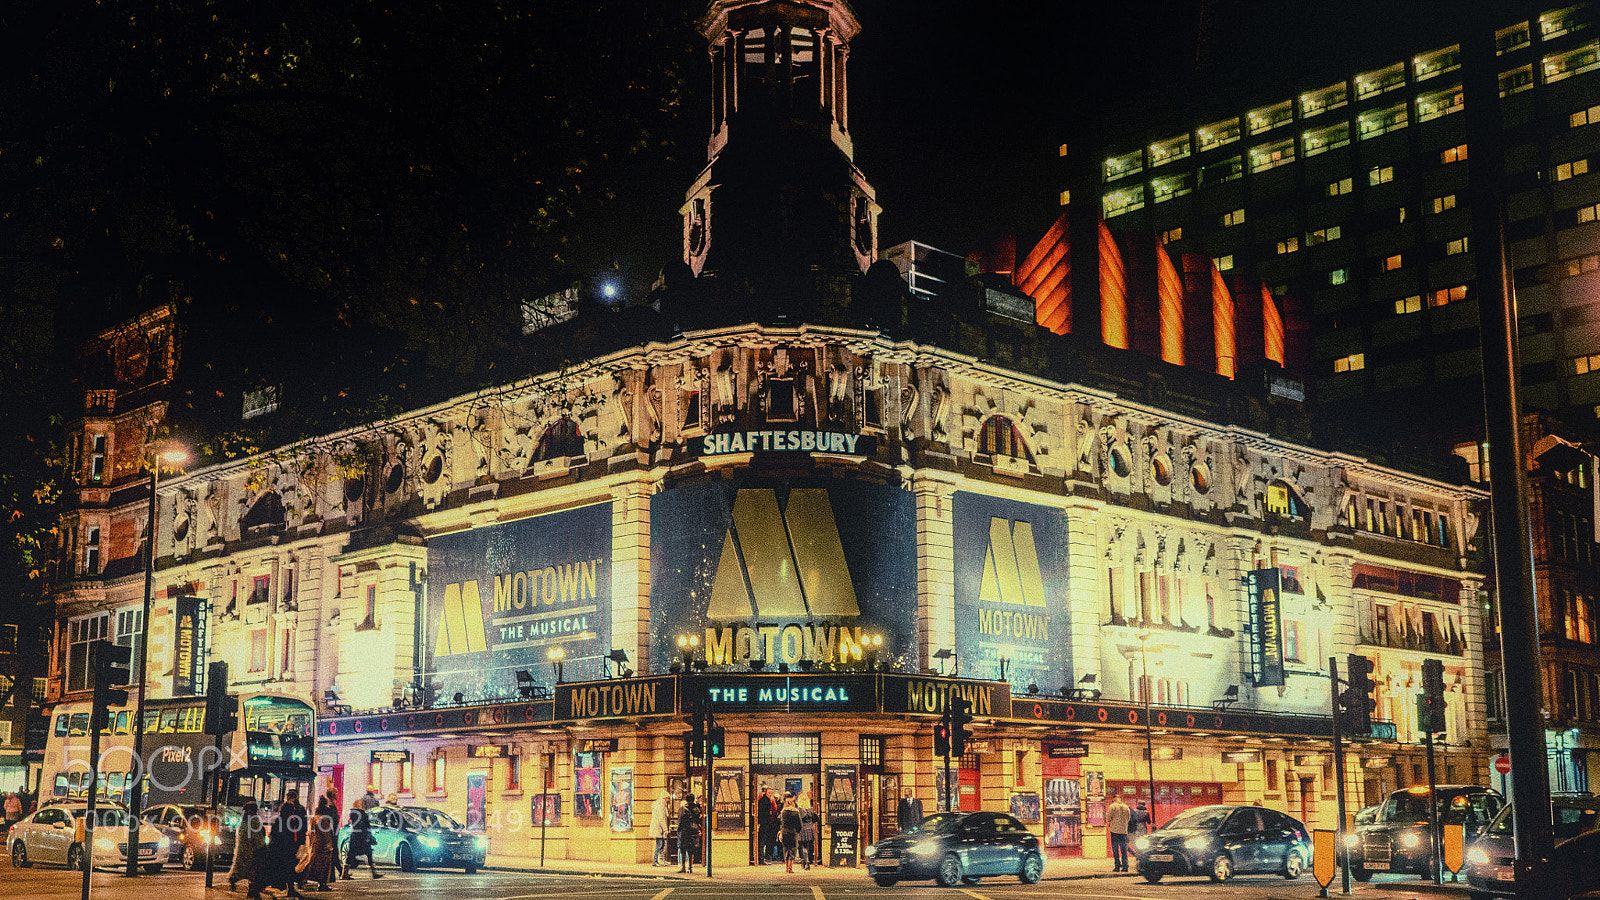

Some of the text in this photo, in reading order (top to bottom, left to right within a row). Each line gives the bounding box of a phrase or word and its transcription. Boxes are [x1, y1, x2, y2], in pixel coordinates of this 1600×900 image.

[703, 430, 860, 455] SHAFTESBURY
[494, 560, 596, 612] MOTOWN
[500, 616, 589, 640] THE MUSICAL
[979, 608, 1049, 640] MOTOWN
[1248, 574, 1262, 683] SHAFTESBURY
[1263, 603, 1278, 659] MOTOWN
[179, 628, 193, 679] MOTOWN
[704, 625, 863, 665] MOTOWN
[571, 682, 656, 717] MOTOWN
[709, 688, 850, 702] THE MUSICAL
[162, 746, 192, 763] Pixel 2
[291, 747, 305, 761] 14
[835, 830, 854, 838] TODAY
